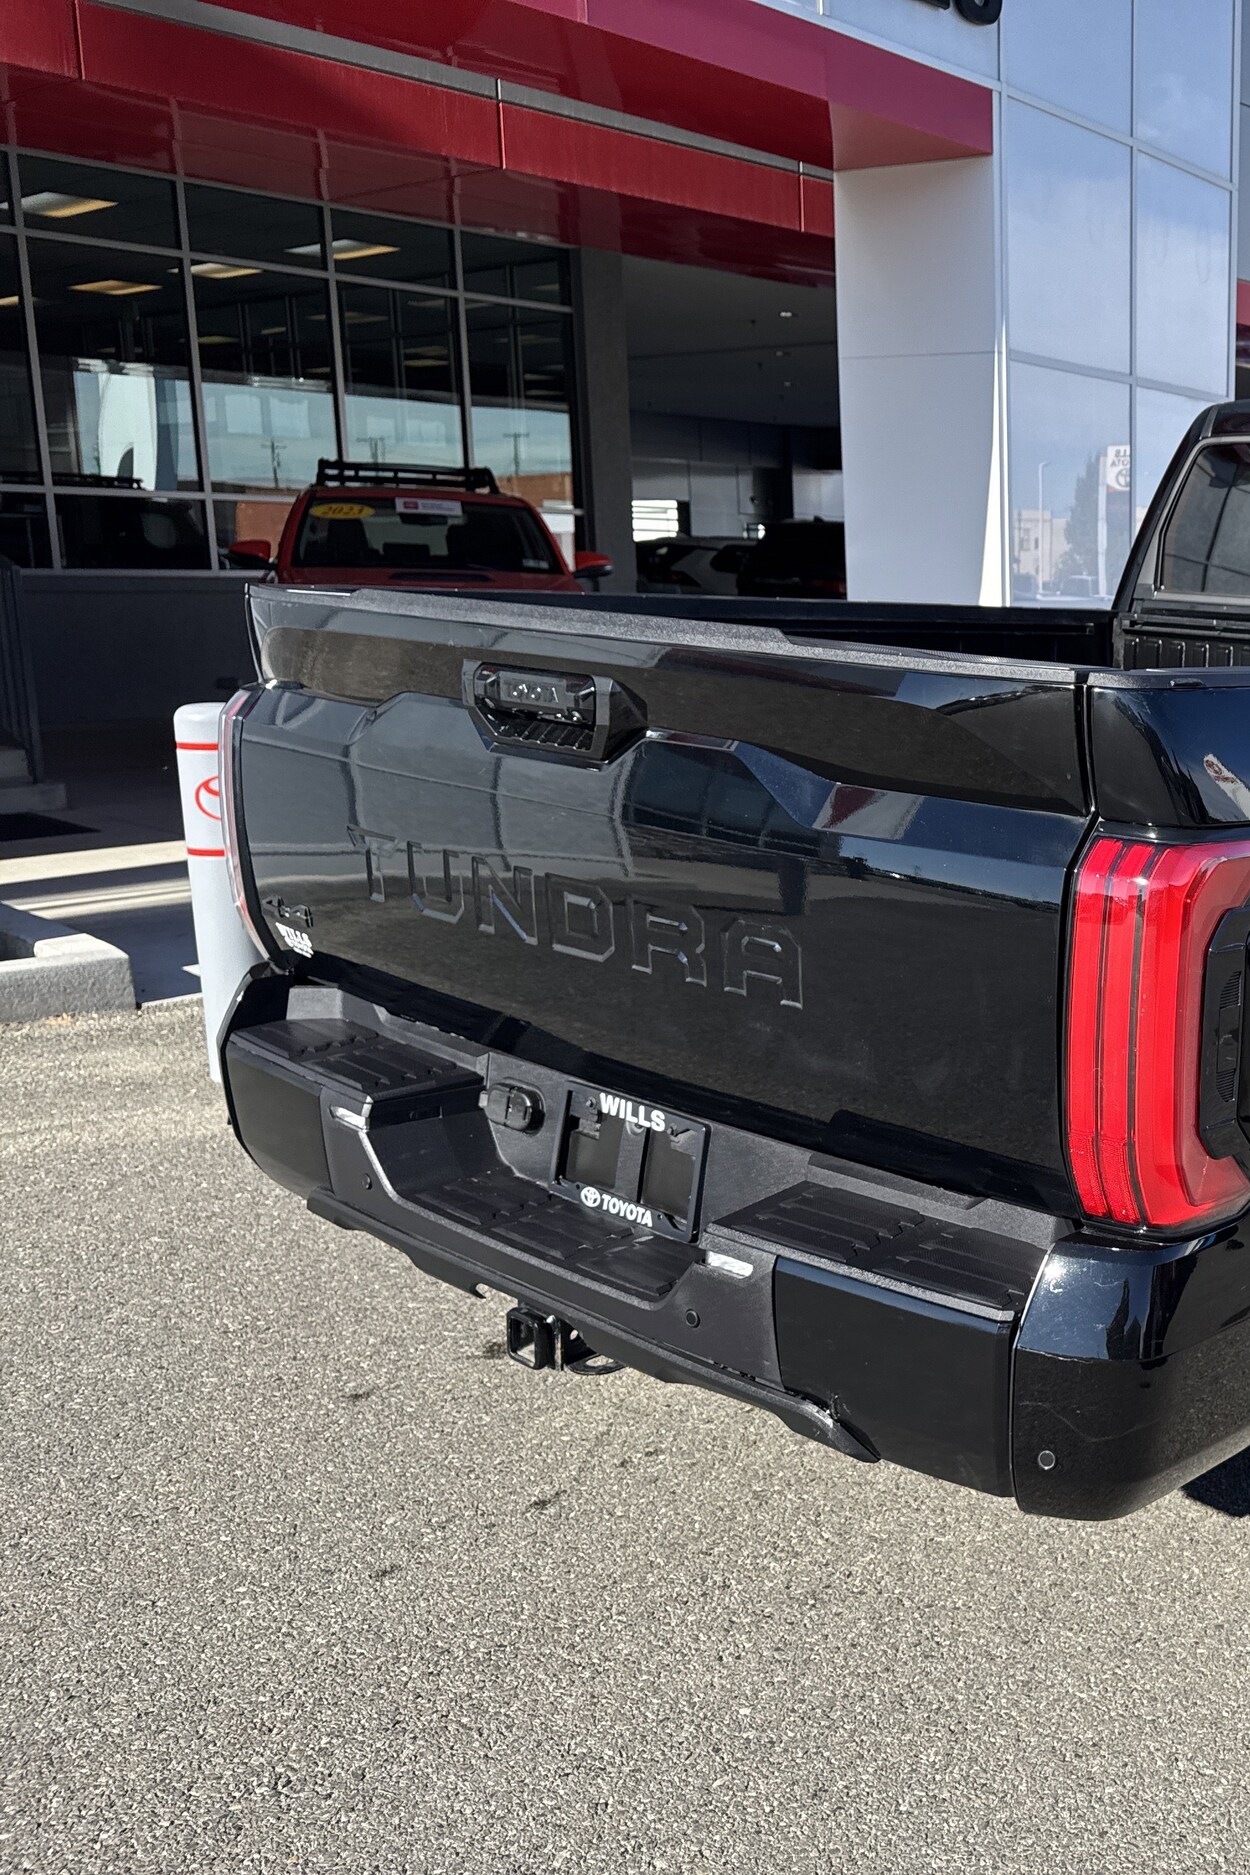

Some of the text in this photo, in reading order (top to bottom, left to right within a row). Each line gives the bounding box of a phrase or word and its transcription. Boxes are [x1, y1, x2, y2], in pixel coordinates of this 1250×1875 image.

[347, 824, 803, 1010] TUNDRA
[600, 1092, 665, 1132] WILLS
[601, 1193, 653, 1227] TOYOTA
